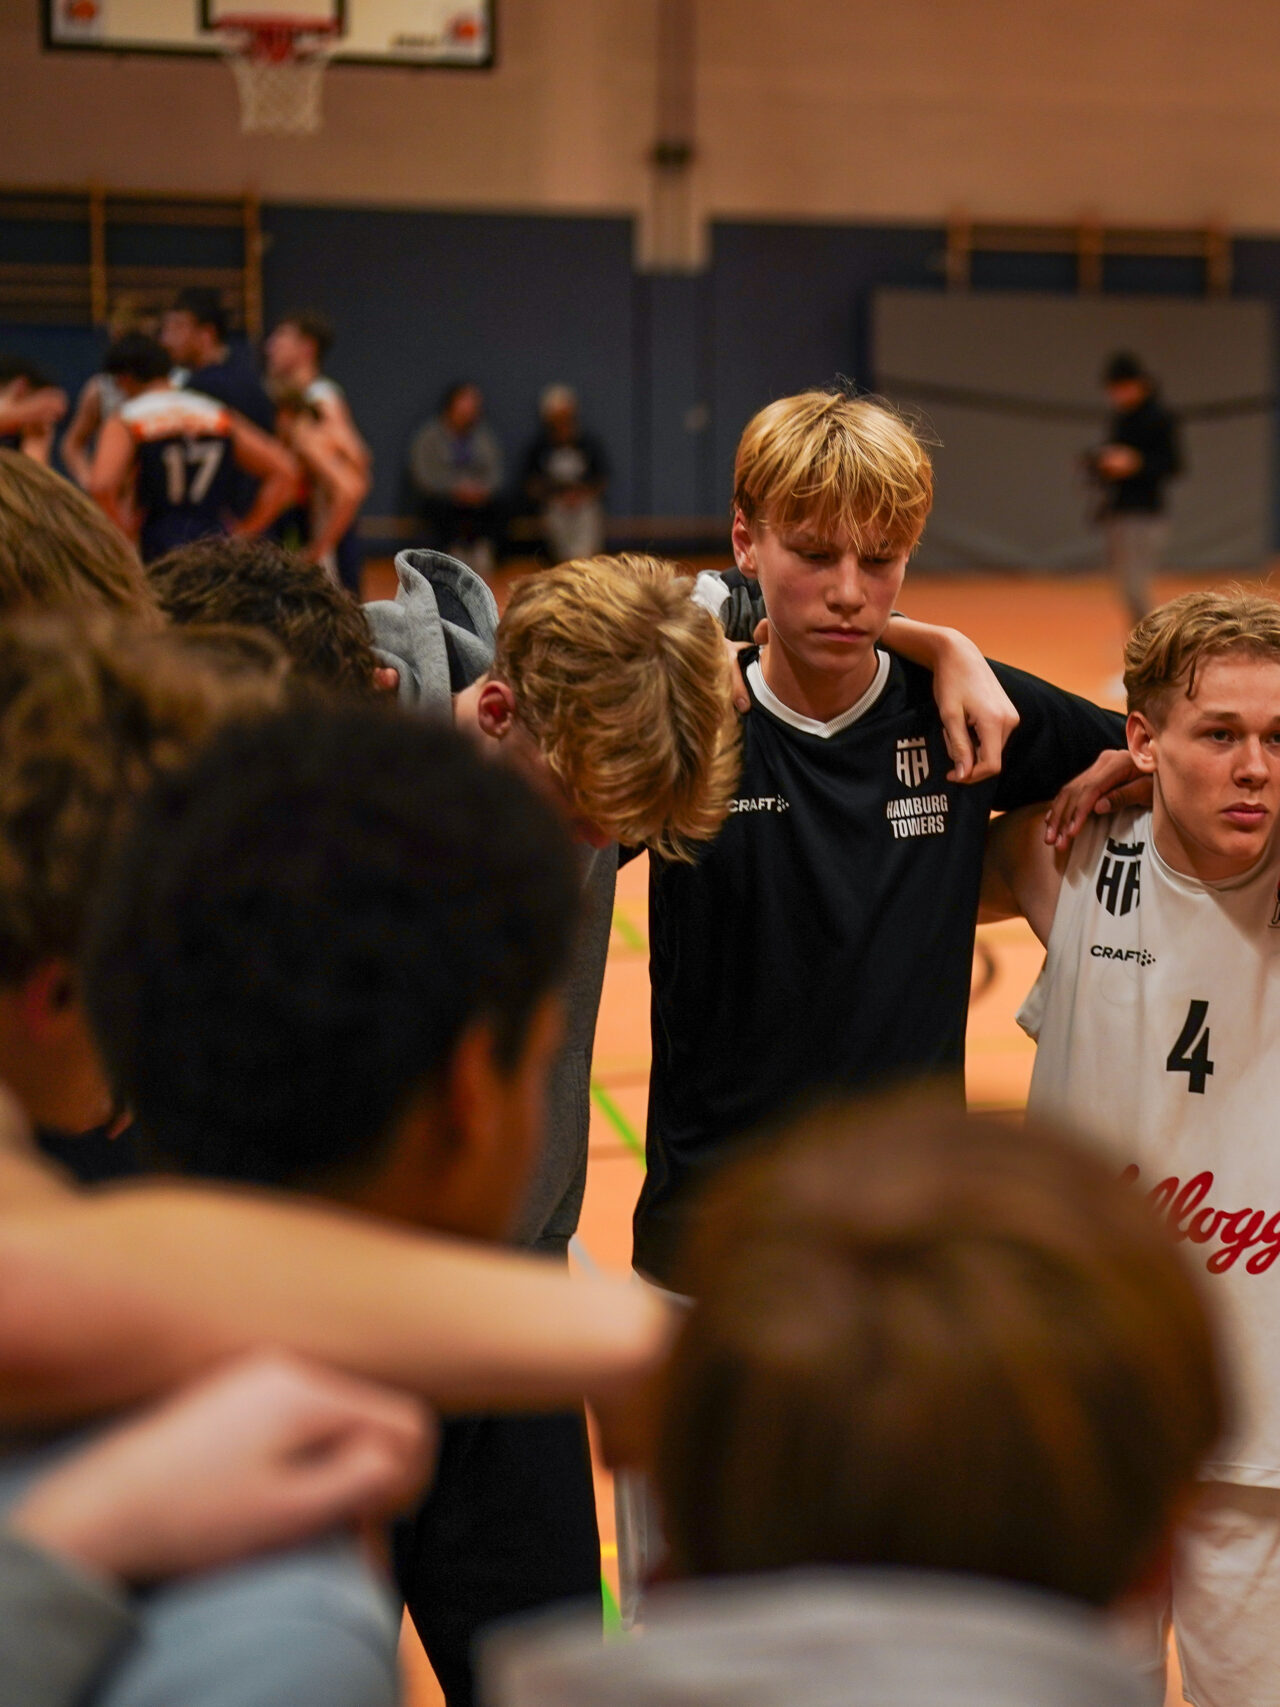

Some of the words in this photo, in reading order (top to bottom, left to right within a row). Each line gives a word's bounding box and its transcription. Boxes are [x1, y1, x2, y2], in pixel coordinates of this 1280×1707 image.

[161, 438, 226, 505] 17
[729, 797, 776, 812] CRAFT
[886, 794, 949, 820] HAMBURG
[891, 814, 945, 839] TOWERS
[1090, 944, 1142, 964] CRAFT
[1166, 999, 1214, 1094] 4
